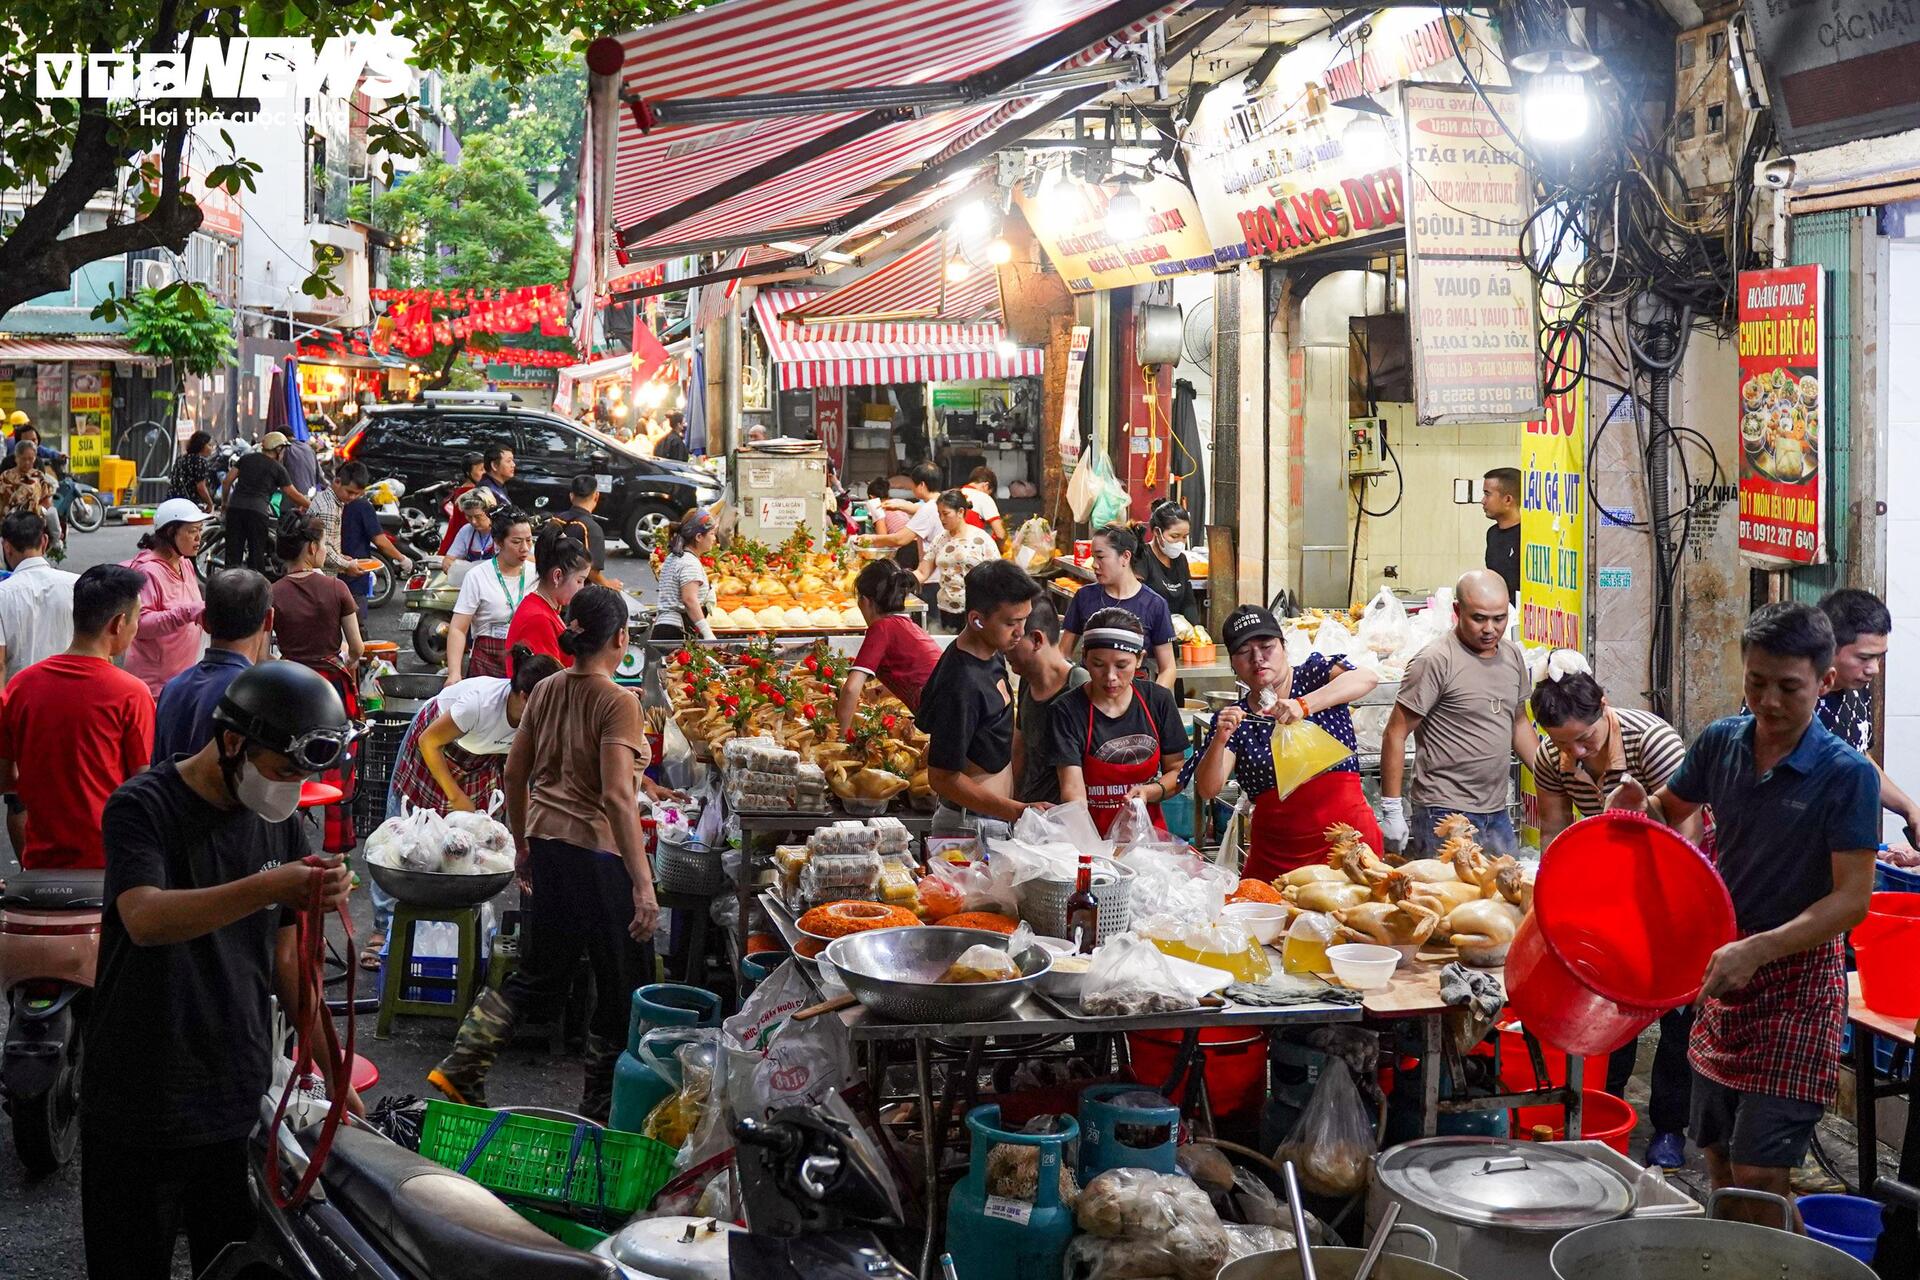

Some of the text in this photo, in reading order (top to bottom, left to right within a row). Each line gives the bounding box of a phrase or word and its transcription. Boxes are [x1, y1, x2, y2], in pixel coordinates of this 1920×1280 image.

[1237, 184, 1341, 256] HOÀNG
[1747, 280, 1806, 309] HOÀNG DUNG
[1740, 304, 1816, 363] CHUYÊN ĐẶT CỖ
[1523, 453, 1580, 523] LẨU GÀ, VỊT
[1713, 483, 1738, 501] NHÀ
[1748, 492, 1752, 514] 1
[1753, 488, 1770, 517] MÓN
[1782, 497, 1796, 522] 100
[1753, 523, 1776, 544] 0912
[1778, 528, 1793, 546] 287
[1796, 530, 1815, 551] 640
[1525, 531, 1578, 592] CHIM, ẾCH
[1234, 618, 1261, 631] DESIGN
